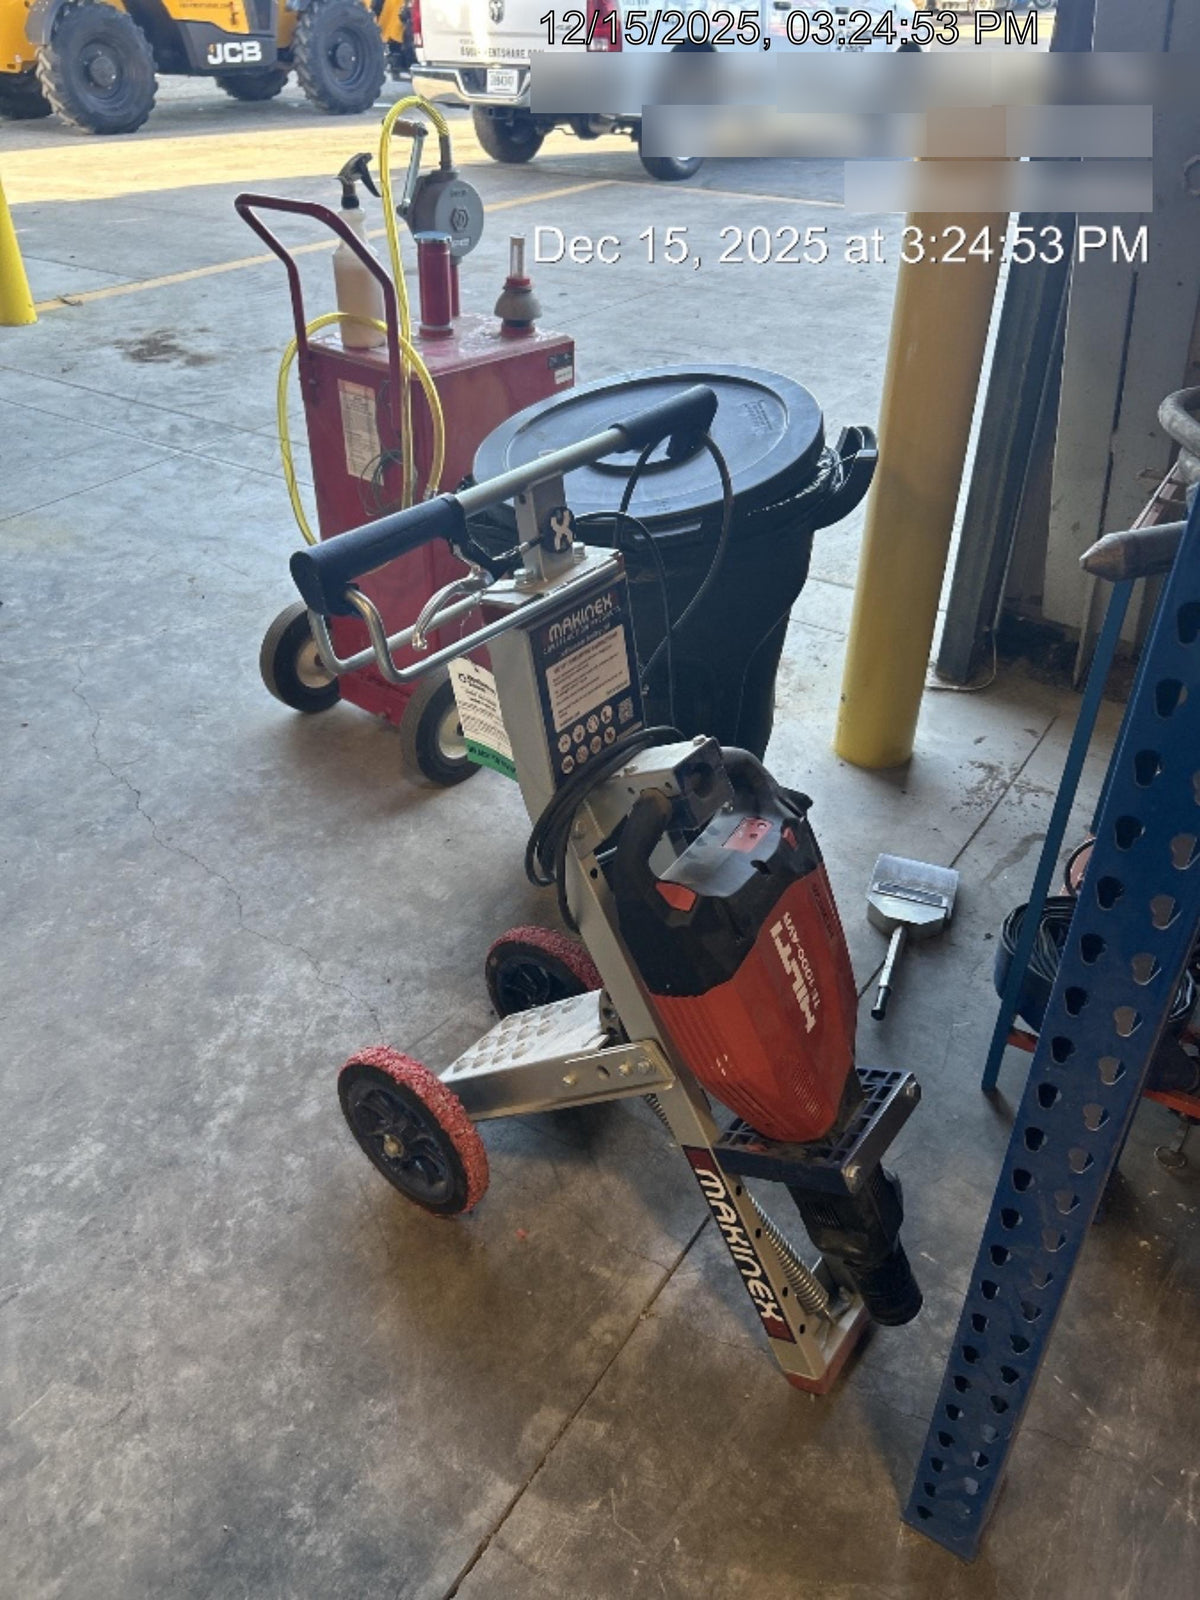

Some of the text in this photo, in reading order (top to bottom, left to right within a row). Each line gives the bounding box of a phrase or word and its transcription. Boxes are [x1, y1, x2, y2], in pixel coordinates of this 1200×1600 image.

[207, 40, 262, 64] JCB
[548, 593, 613, 643] MAKINEX
[695, 1167, 784, 1323] MAKINEX
